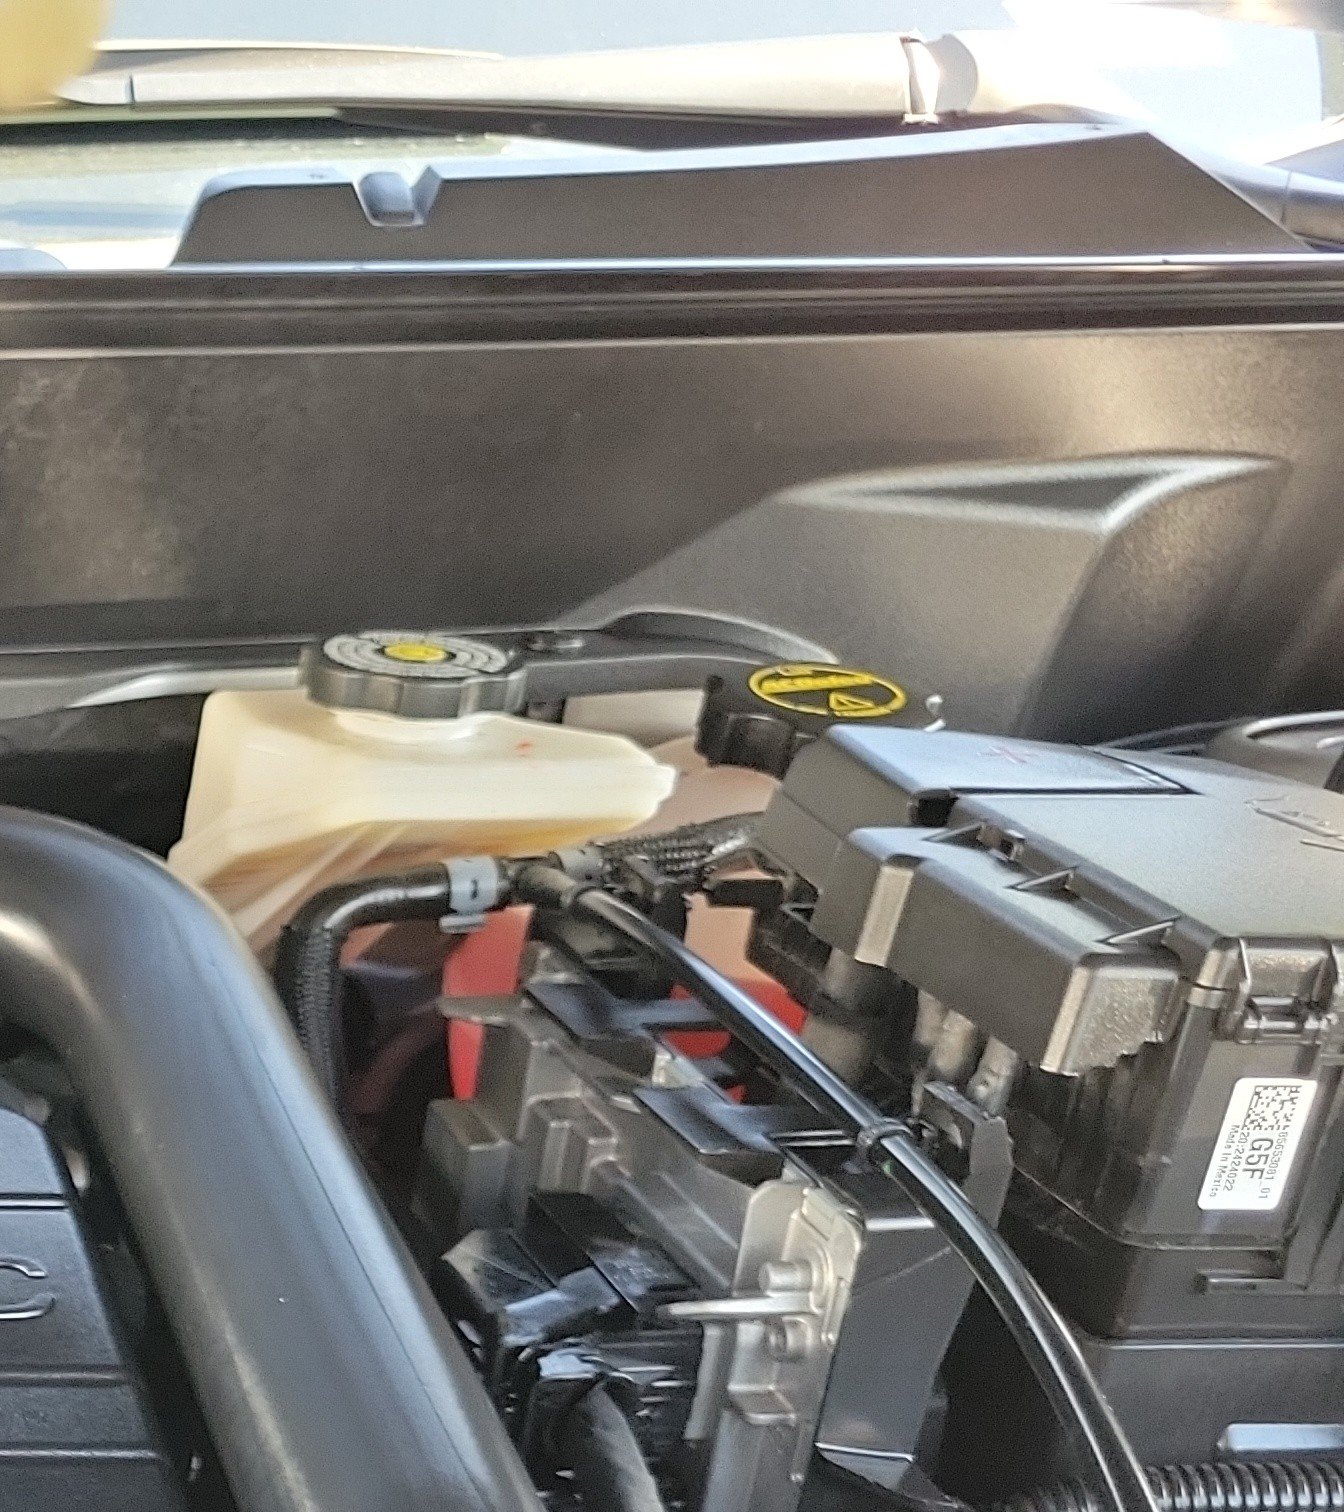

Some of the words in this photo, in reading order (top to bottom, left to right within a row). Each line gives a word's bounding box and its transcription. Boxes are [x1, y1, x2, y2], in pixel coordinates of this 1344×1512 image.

[1224, 1124, 1240, 1149] Made
[1242, 1138, 1274, 1180] G5F
[1209, 1165, 1228, 1197] Mexico
